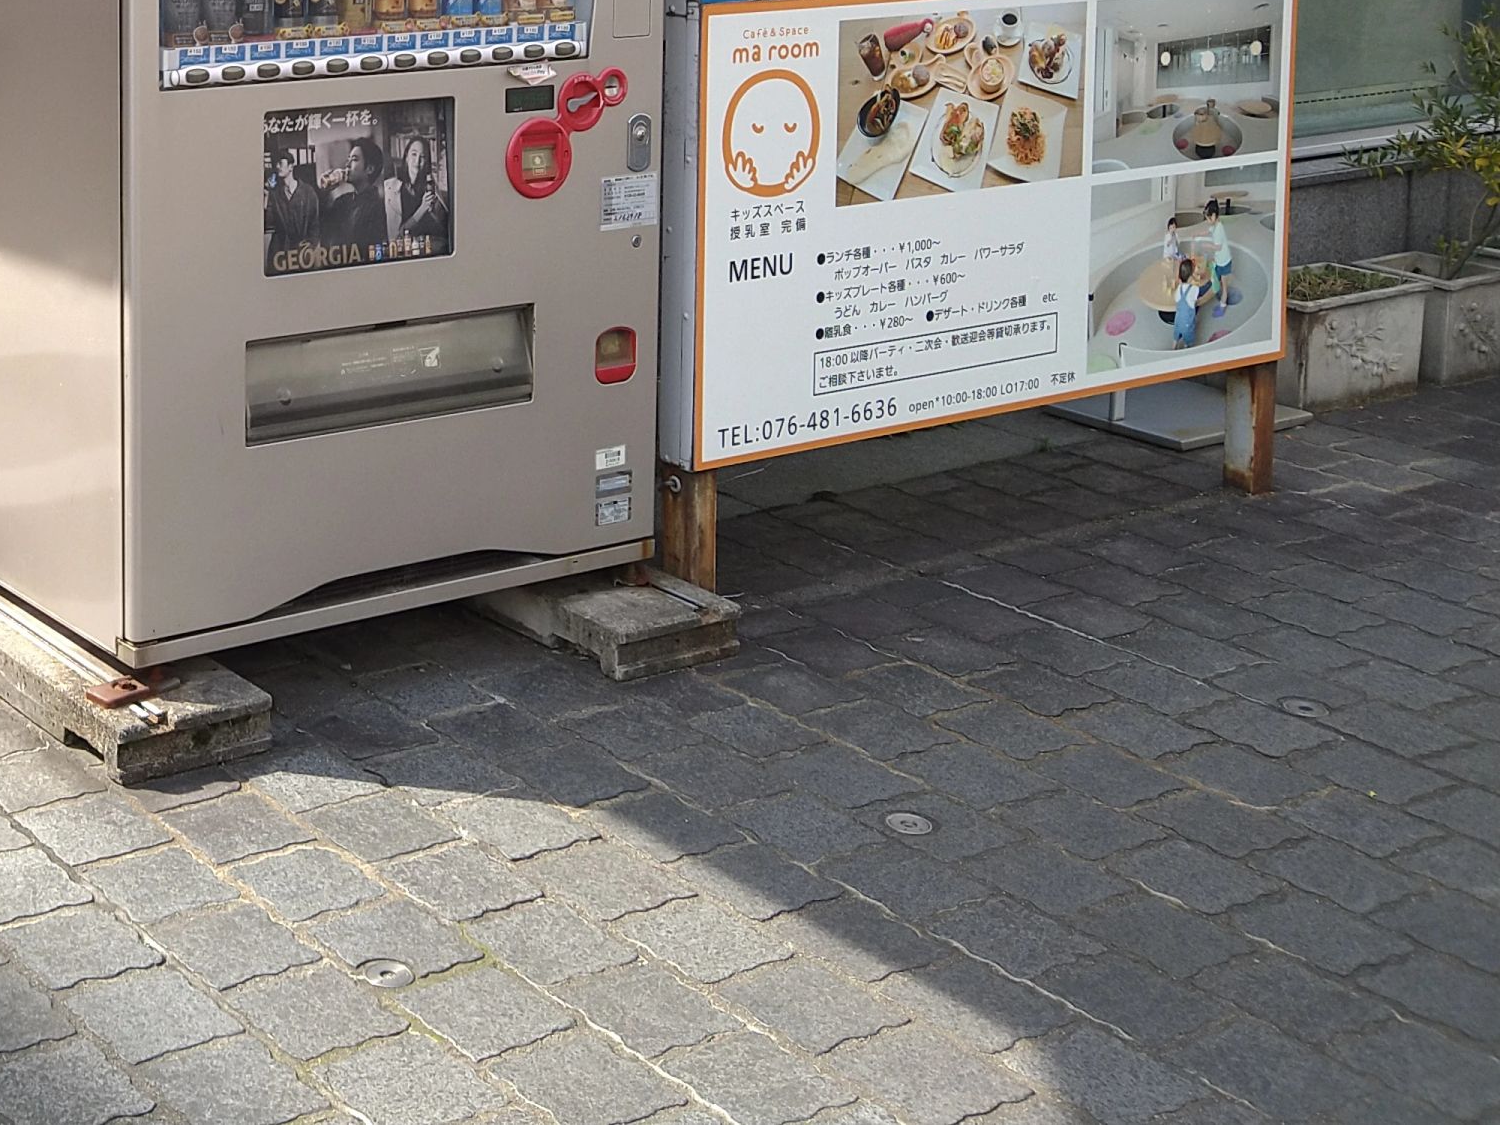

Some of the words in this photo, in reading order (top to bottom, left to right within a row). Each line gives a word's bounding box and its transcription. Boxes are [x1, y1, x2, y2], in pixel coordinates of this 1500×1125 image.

[779, 26, 809, 38] Space
[732, 44, 762, 64] ma
[768, 41, 820, 62] room
[730, 200, 805, 222] キッズスペース
[730, 222, 771, 241] 授乳室
[781, 217, 807, 234] 完備
[273, 241, 362, 272] GEORGIA
[729, 252, 793, 283] MENU
[940, 253, 966, 265] カレー
[834, 304, 861, 319] うどん
[869, 301, 896, 315] カレー
[1050, 371, 1076, 386] 不定休
[717, 396, 898, 449] TEL:076-481-6636
